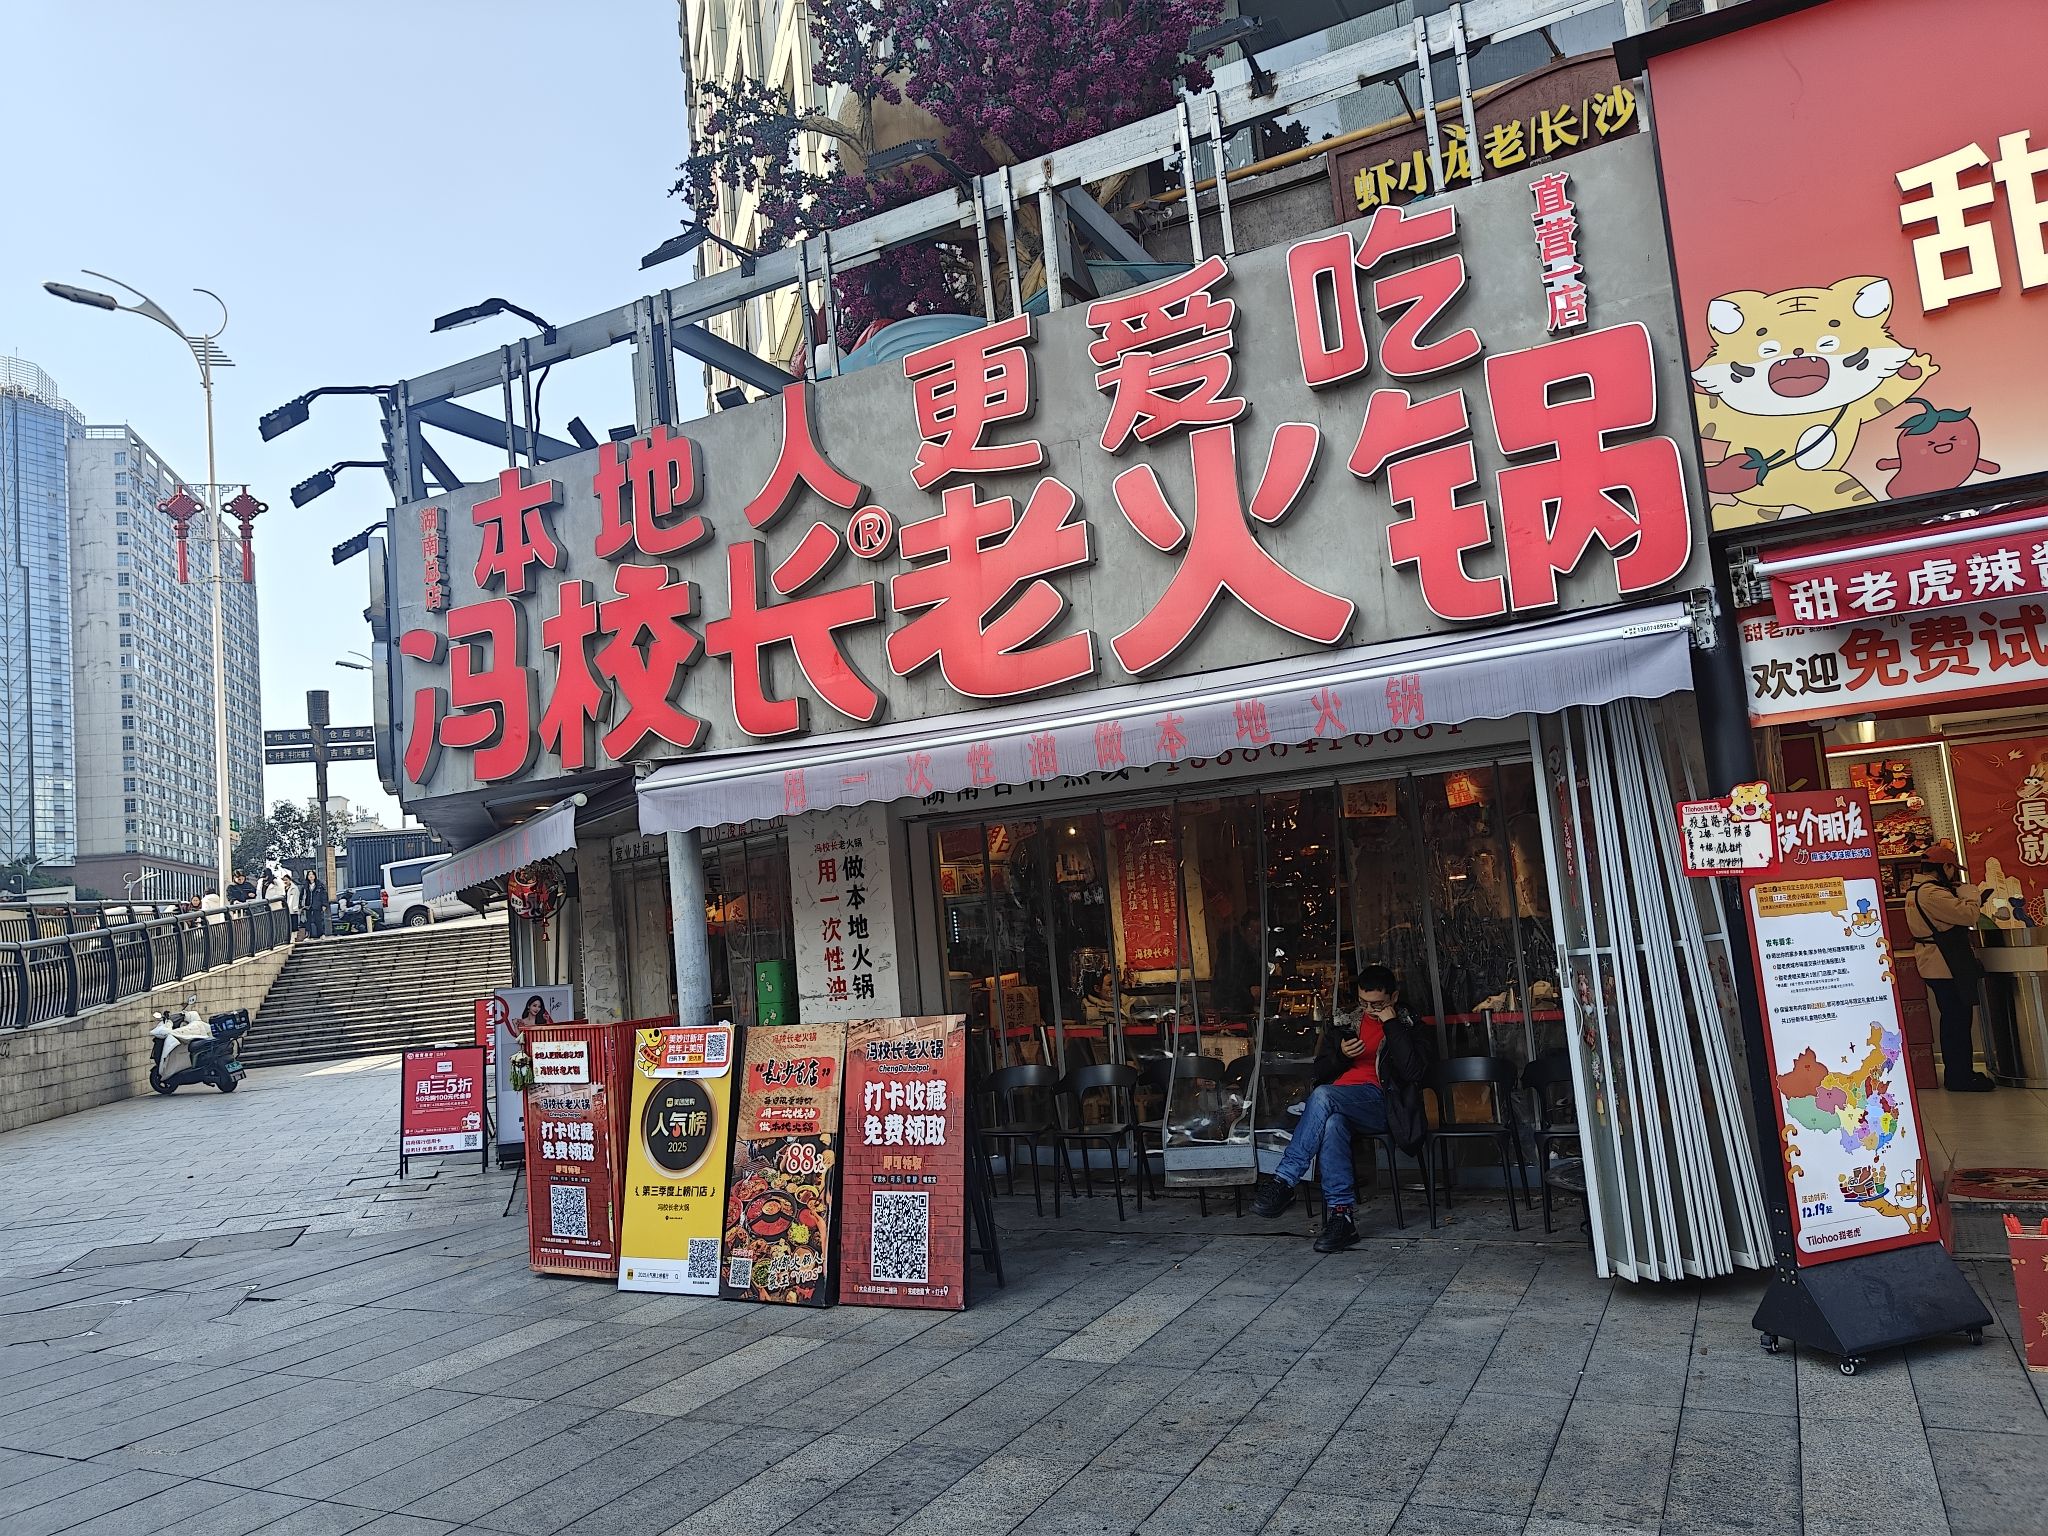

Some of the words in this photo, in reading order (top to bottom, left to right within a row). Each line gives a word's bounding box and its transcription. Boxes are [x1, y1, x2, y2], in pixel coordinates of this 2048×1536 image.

[1529, 171, 1590, 335] 直营一店
[472, 206, 1484, 594] 本地人更爱吃
[420, 505, 442, 610] 湖南总店
[329, 729, 364, 739] 仓后街
[330, 747, 365, 757] 吉祥巷
[814, 838, 864, 853] 冯校长老火锅
[818, 858, 848, 1001] 用一次性油
[843, 855, 875, 1000] 做本地火锅
[669, 1033, 704, 1044] 美妙过新年
[866, 1040, 944, 1060] 冯校长老火锅
[416, 1078, 472, 1095] 周三5折
[864, 1080, 947, 1111] 打卡收藏
[541, 1098, 590, 1110] 冯校长老火锅
[761, 1107, 816, 1119] 用一次性油
[541, 1121, 594, 1140] 打卡收藏
[651, 1111, 707, 1137] 人气榜
[863, 1113, 946, 1145] 免费领取
[543, 1141, 595, 1161] 免费领取
[668, 1142, 688, 1153] 2025
[642, 1185, 708, 1198] 第三季度上榜门店
[657, 1203, 690, 1212] 冯校长老火锅
